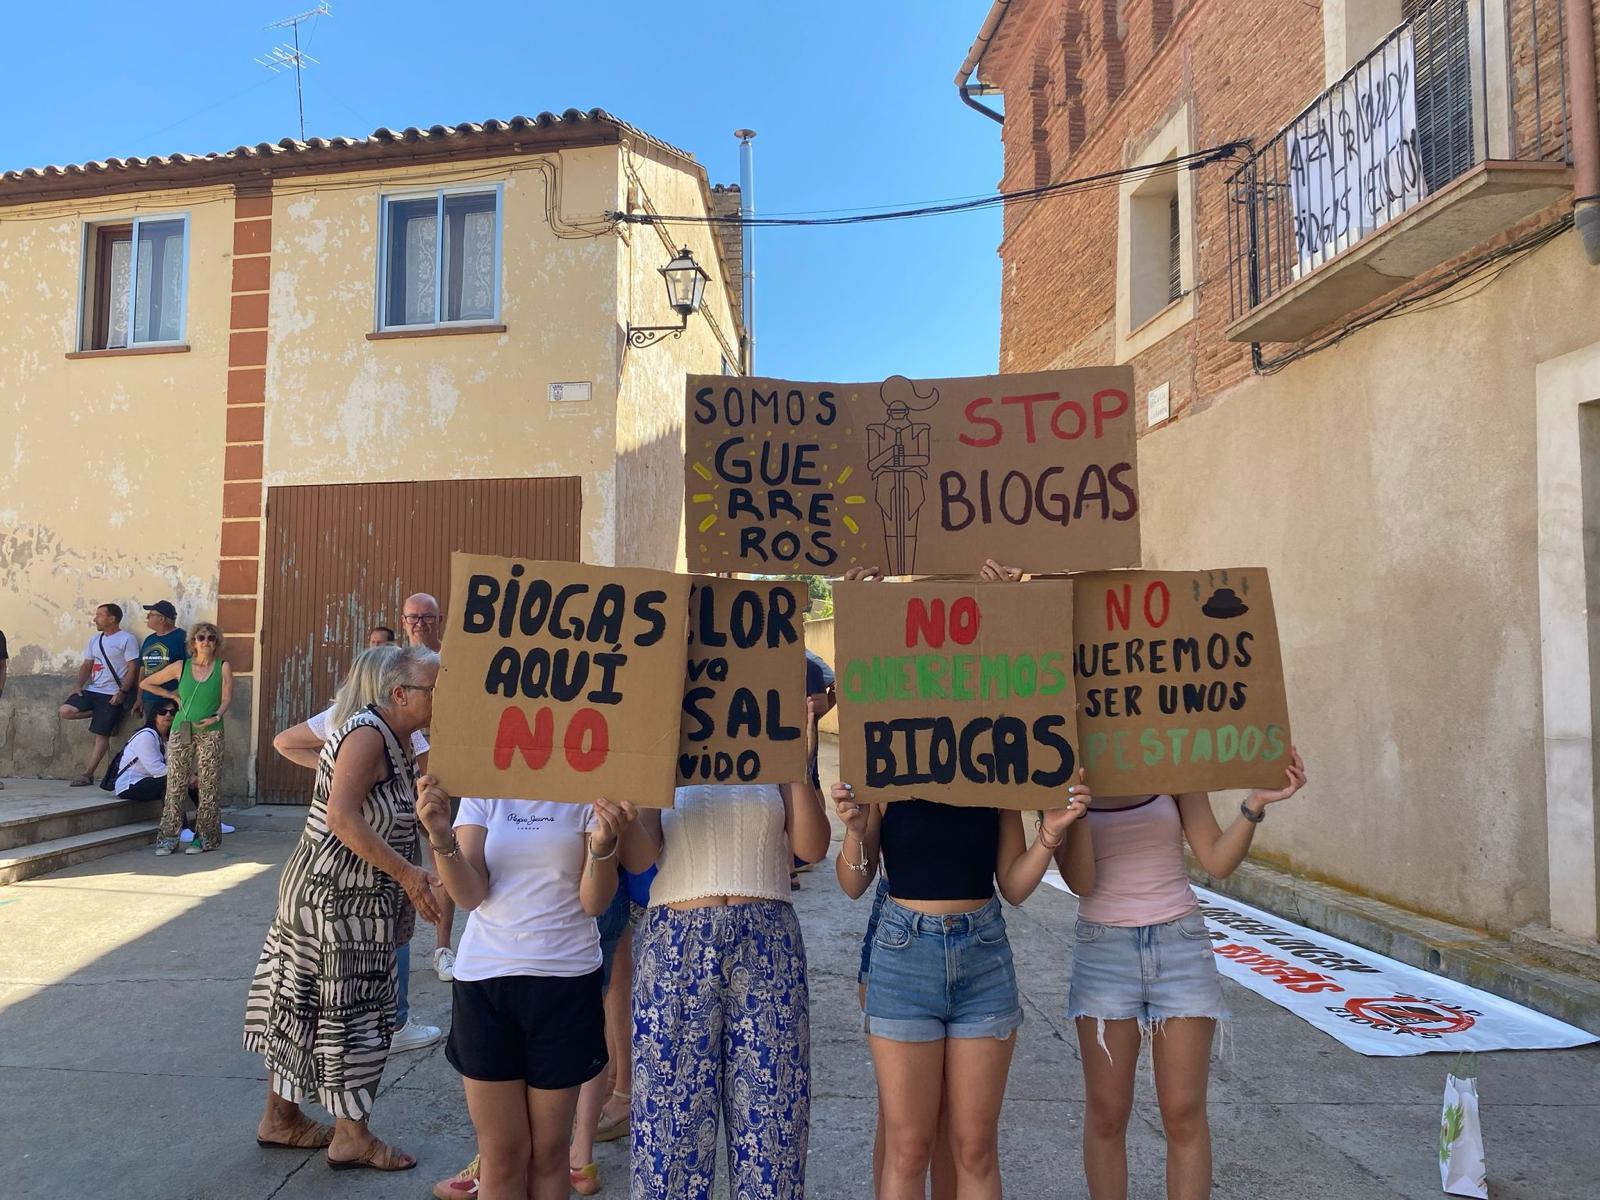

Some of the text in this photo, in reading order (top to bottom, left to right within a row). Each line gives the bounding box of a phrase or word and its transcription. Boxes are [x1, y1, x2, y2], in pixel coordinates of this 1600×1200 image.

[693, 386, 837, 426] SOMOS
[958, 388, 1129, 448] STOP
[714, 436, 822, 486] GUE
[728, 488, 835, 526] RRE
[939, 462, 1139, 531] BIOGAS
[740, 526, 838, 567] ROS
[905, 596, 981, 649] NO
[1105, 580, 1170, 632] NO
[484, 643, 628, 705] AQUÍ
[842, 651, 1067, 703] QUEREMOS
[1073, 631, 1255, 679] UEREMOS
[1085, 680, 1248, 717] SER UNOS
[492, 706, 610, 772] NO
[864, 714, 1075, 788] BIOGAS
